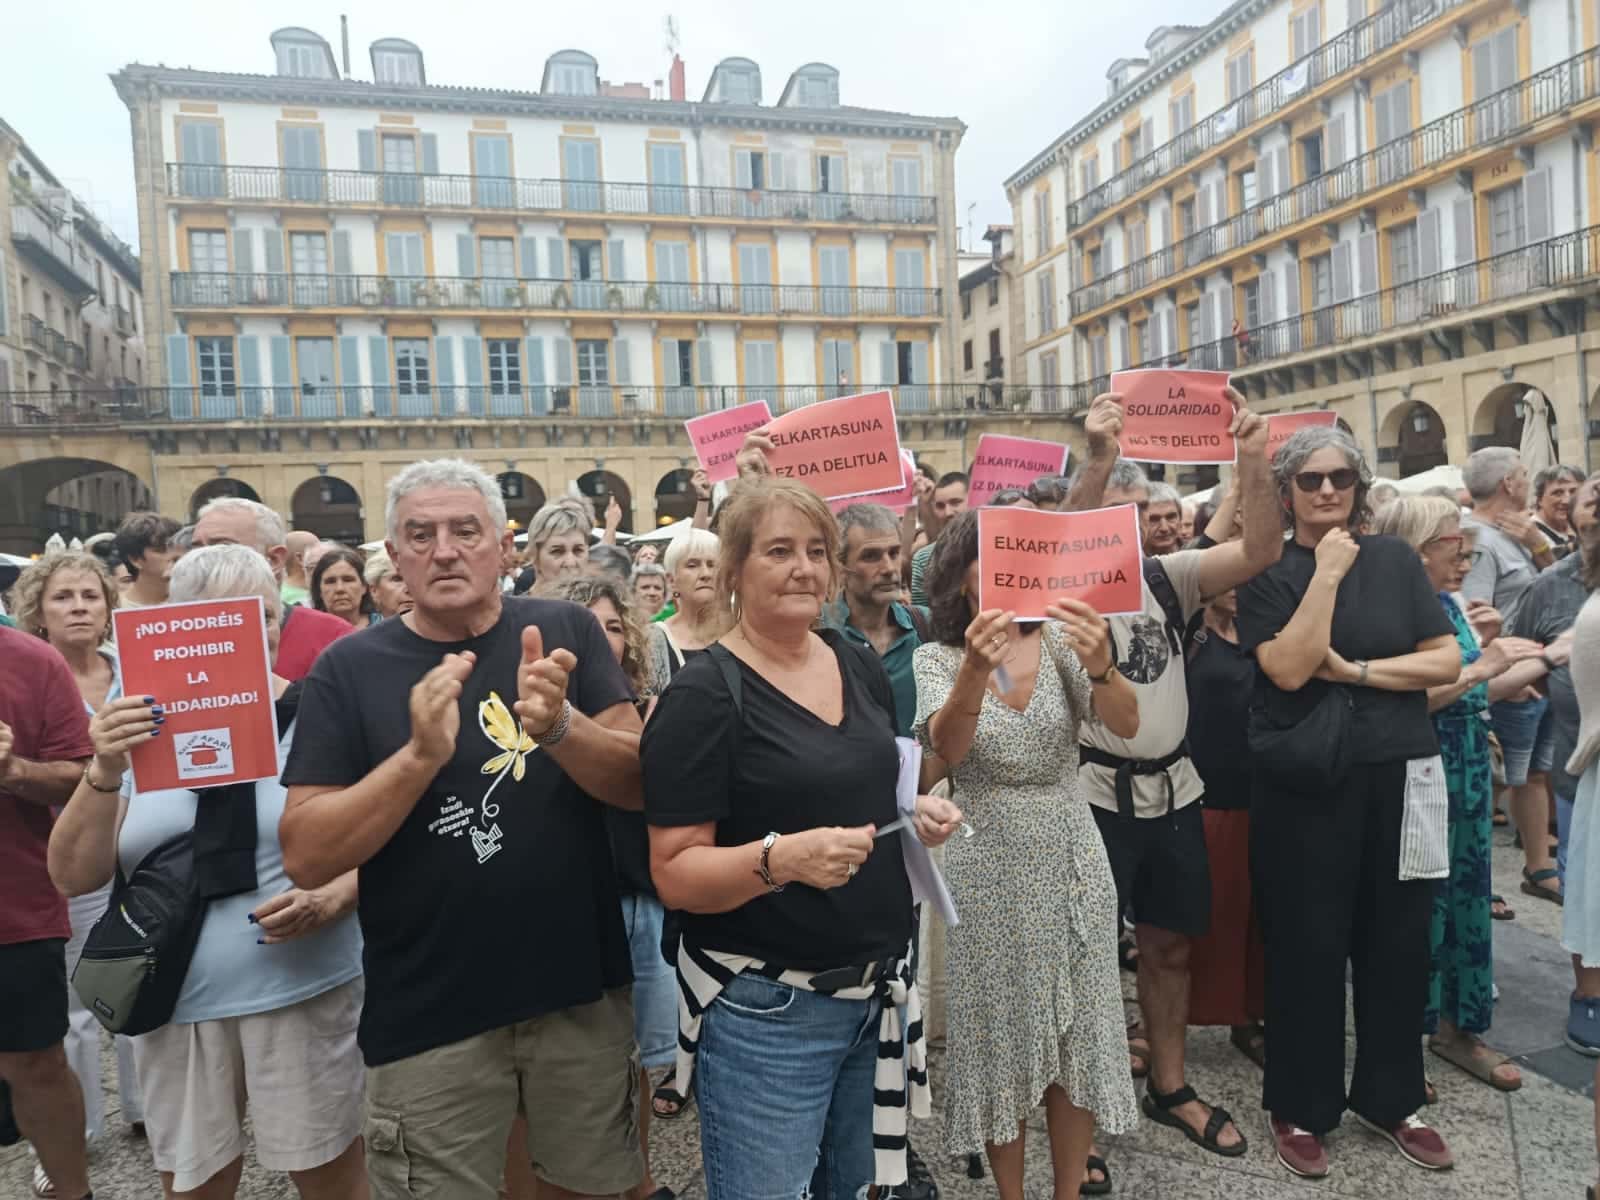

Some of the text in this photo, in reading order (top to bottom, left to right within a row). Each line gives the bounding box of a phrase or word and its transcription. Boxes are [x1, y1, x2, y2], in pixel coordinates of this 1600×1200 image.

[1168, 387, 1186, 399] LA
[1127, 403, 1221, 417] SOLIDARIDAD
[770, 418, 883, 447] ELKARTASUNA
[1129, 434, 1220, 448] NO ES DELITO
[707, 455, 720, 466] EZ
[721, 451, 735, 462] DA
[798, 462, 820, 476] DA
[824, 451, 888, 472] DELITUA
[976, 455, 1054, 473] ELKARTASUNA
[972, 480, 985, 491] EZ
[987, 481, 1003, 491] DA
[994, 533, 1123, 555] ELKARTASUNA
[994, 569, 1127, 590] EZ DA DELITUA
[136, 611, 243, 639] ¡NO PODRÉIS
[154, 641, 235, 661] PROHIBIR
[187, 671, 209, 684] LA
[153, 691, 258, 714] LIDARIDAD!
